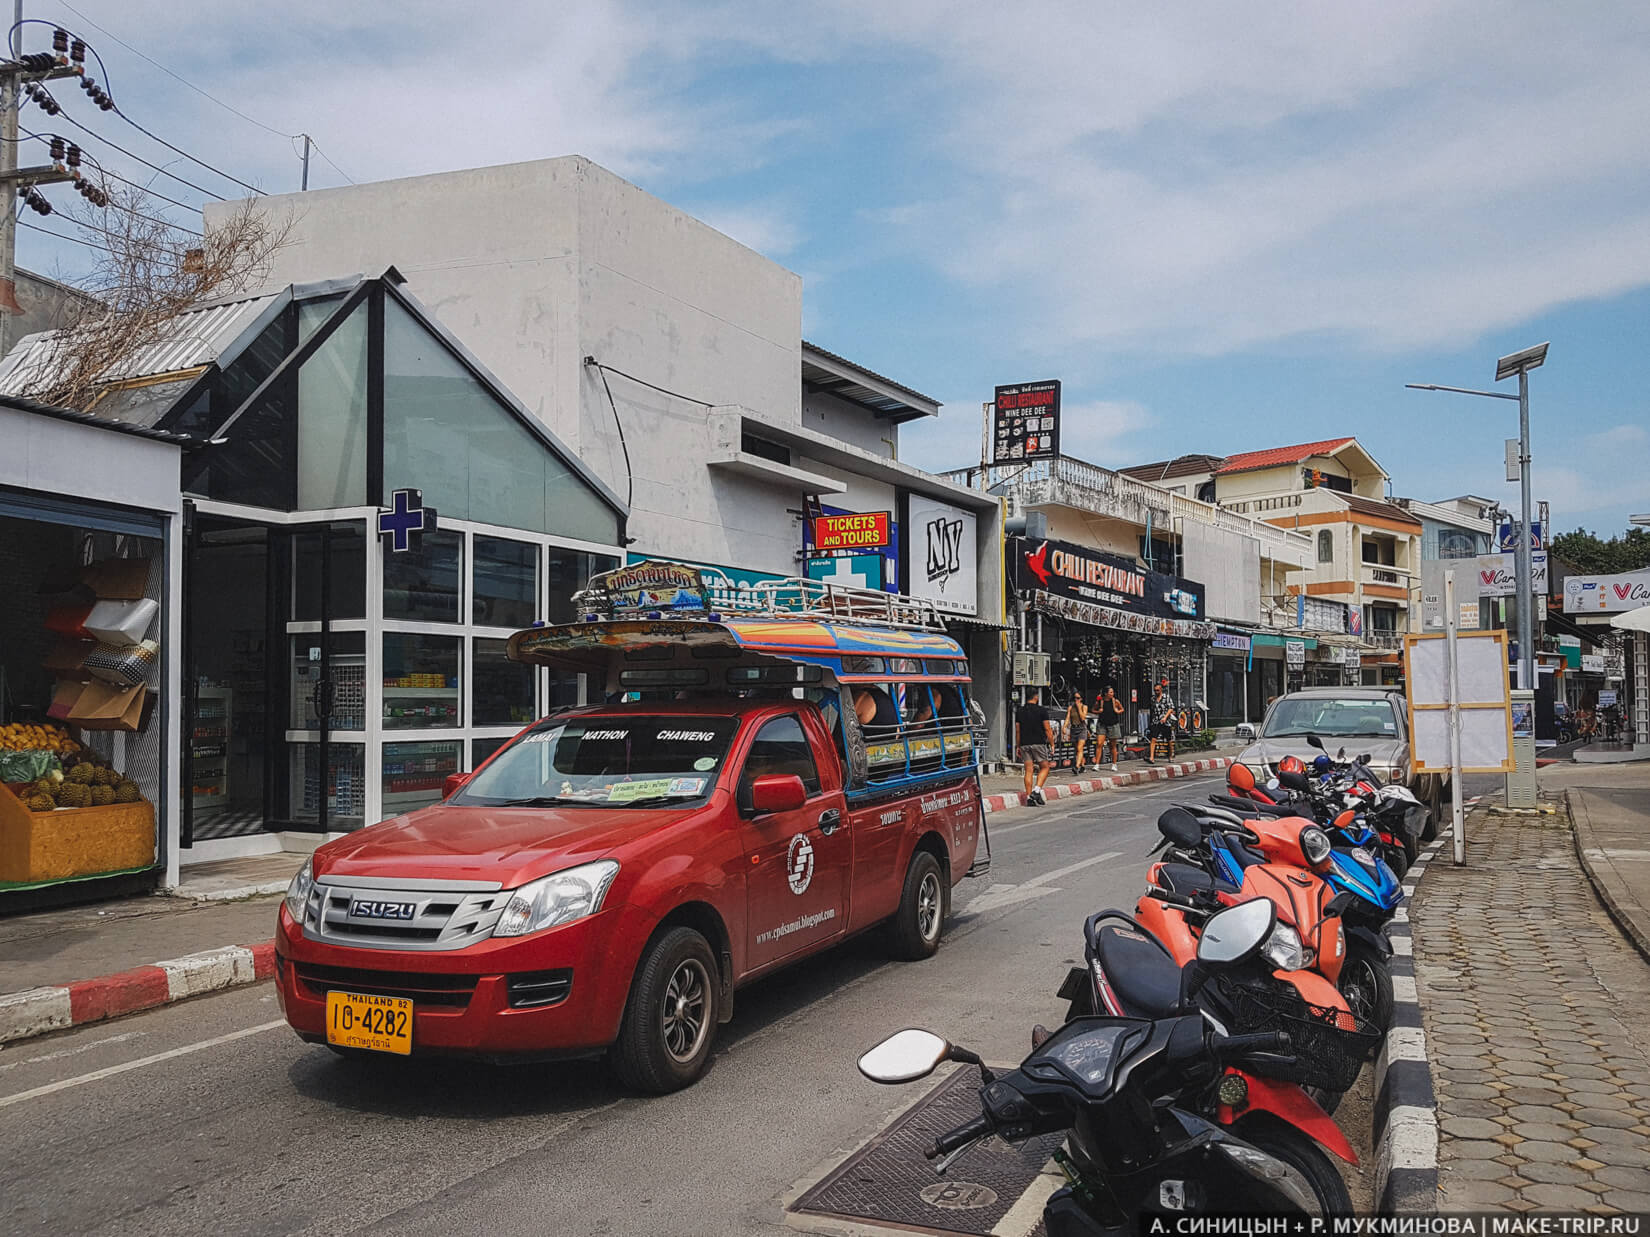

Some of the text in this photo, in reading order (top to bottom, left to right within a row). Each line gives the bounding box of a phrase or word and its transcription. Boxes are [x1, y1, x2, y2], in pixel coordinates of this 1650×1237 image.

[998, 390, 1054, 408] CHILLI RESTAURANT
[1022, 408, 1032, 416] DEE
[1034, 406, 1046, 415] DEE
[827, 516, 875, 531] TICKETS
[824, 530, 880, 546] AND TOURS
[927, 517, 962, 575] NY
[1052, 550, 1145, 598] CHILLI RESTAURANT
[581, 730, 629, 741] NATHON
[656, 730, 715, 742] CHAWENG
[351, 901, 414, 919] ISUZU
[756, 909, 835, 944] www.cpdsamui.blogspot.com
[346, 994, 393, 1007] THAILAND
[333, 1003, 408, 1039] 10-4282
